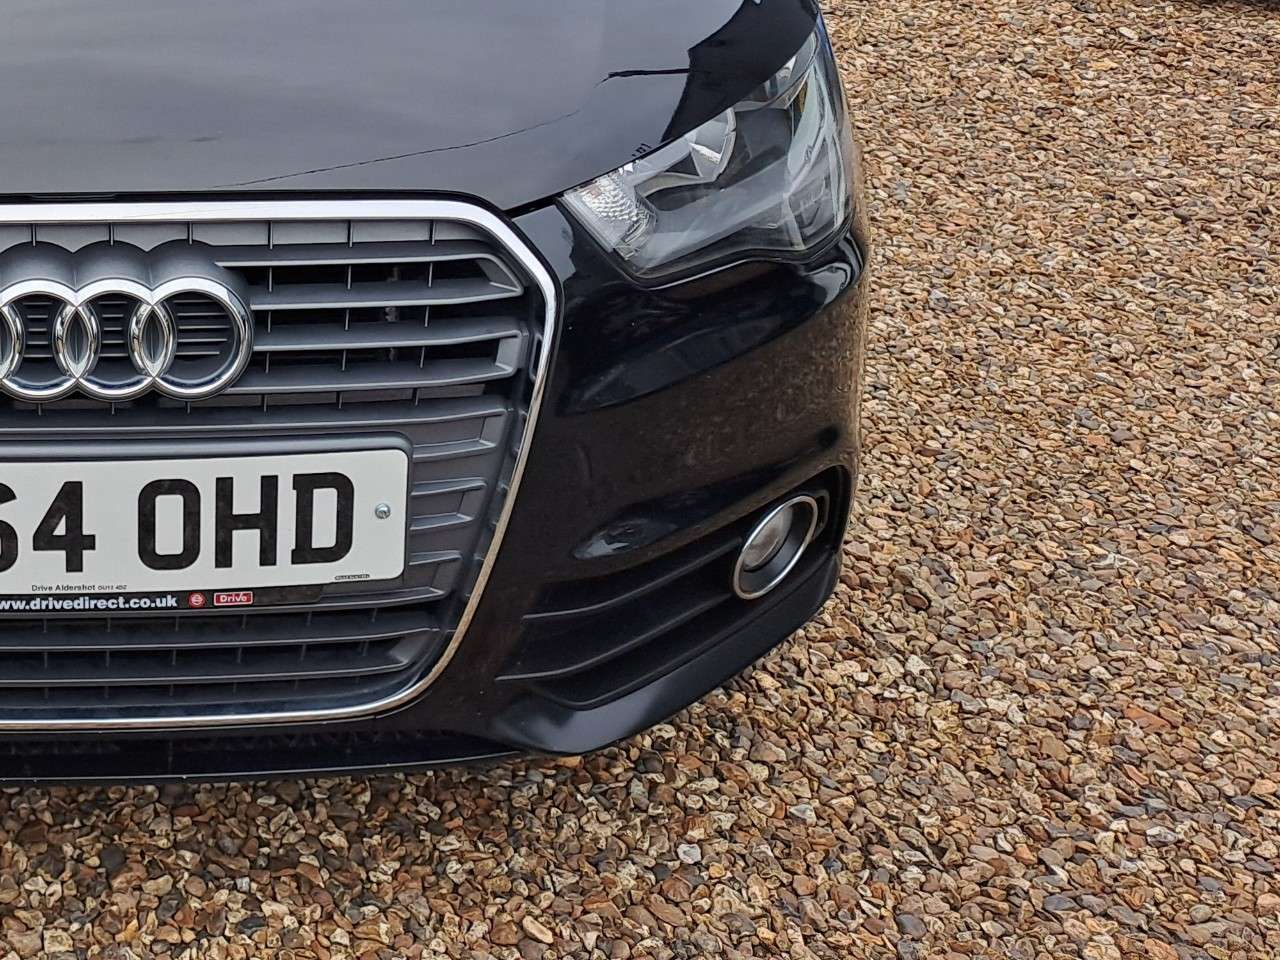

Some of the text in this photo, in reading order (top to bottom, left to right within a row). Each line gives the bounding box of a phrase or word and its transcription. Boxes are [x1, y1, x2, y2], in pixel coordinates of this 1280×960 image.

[137, 471, 355, 570] OHD
[31, 584, 53, 592] Drive
[55, 584, 96, 592] Aldershot
[220, 593, 248, 603] Drive
